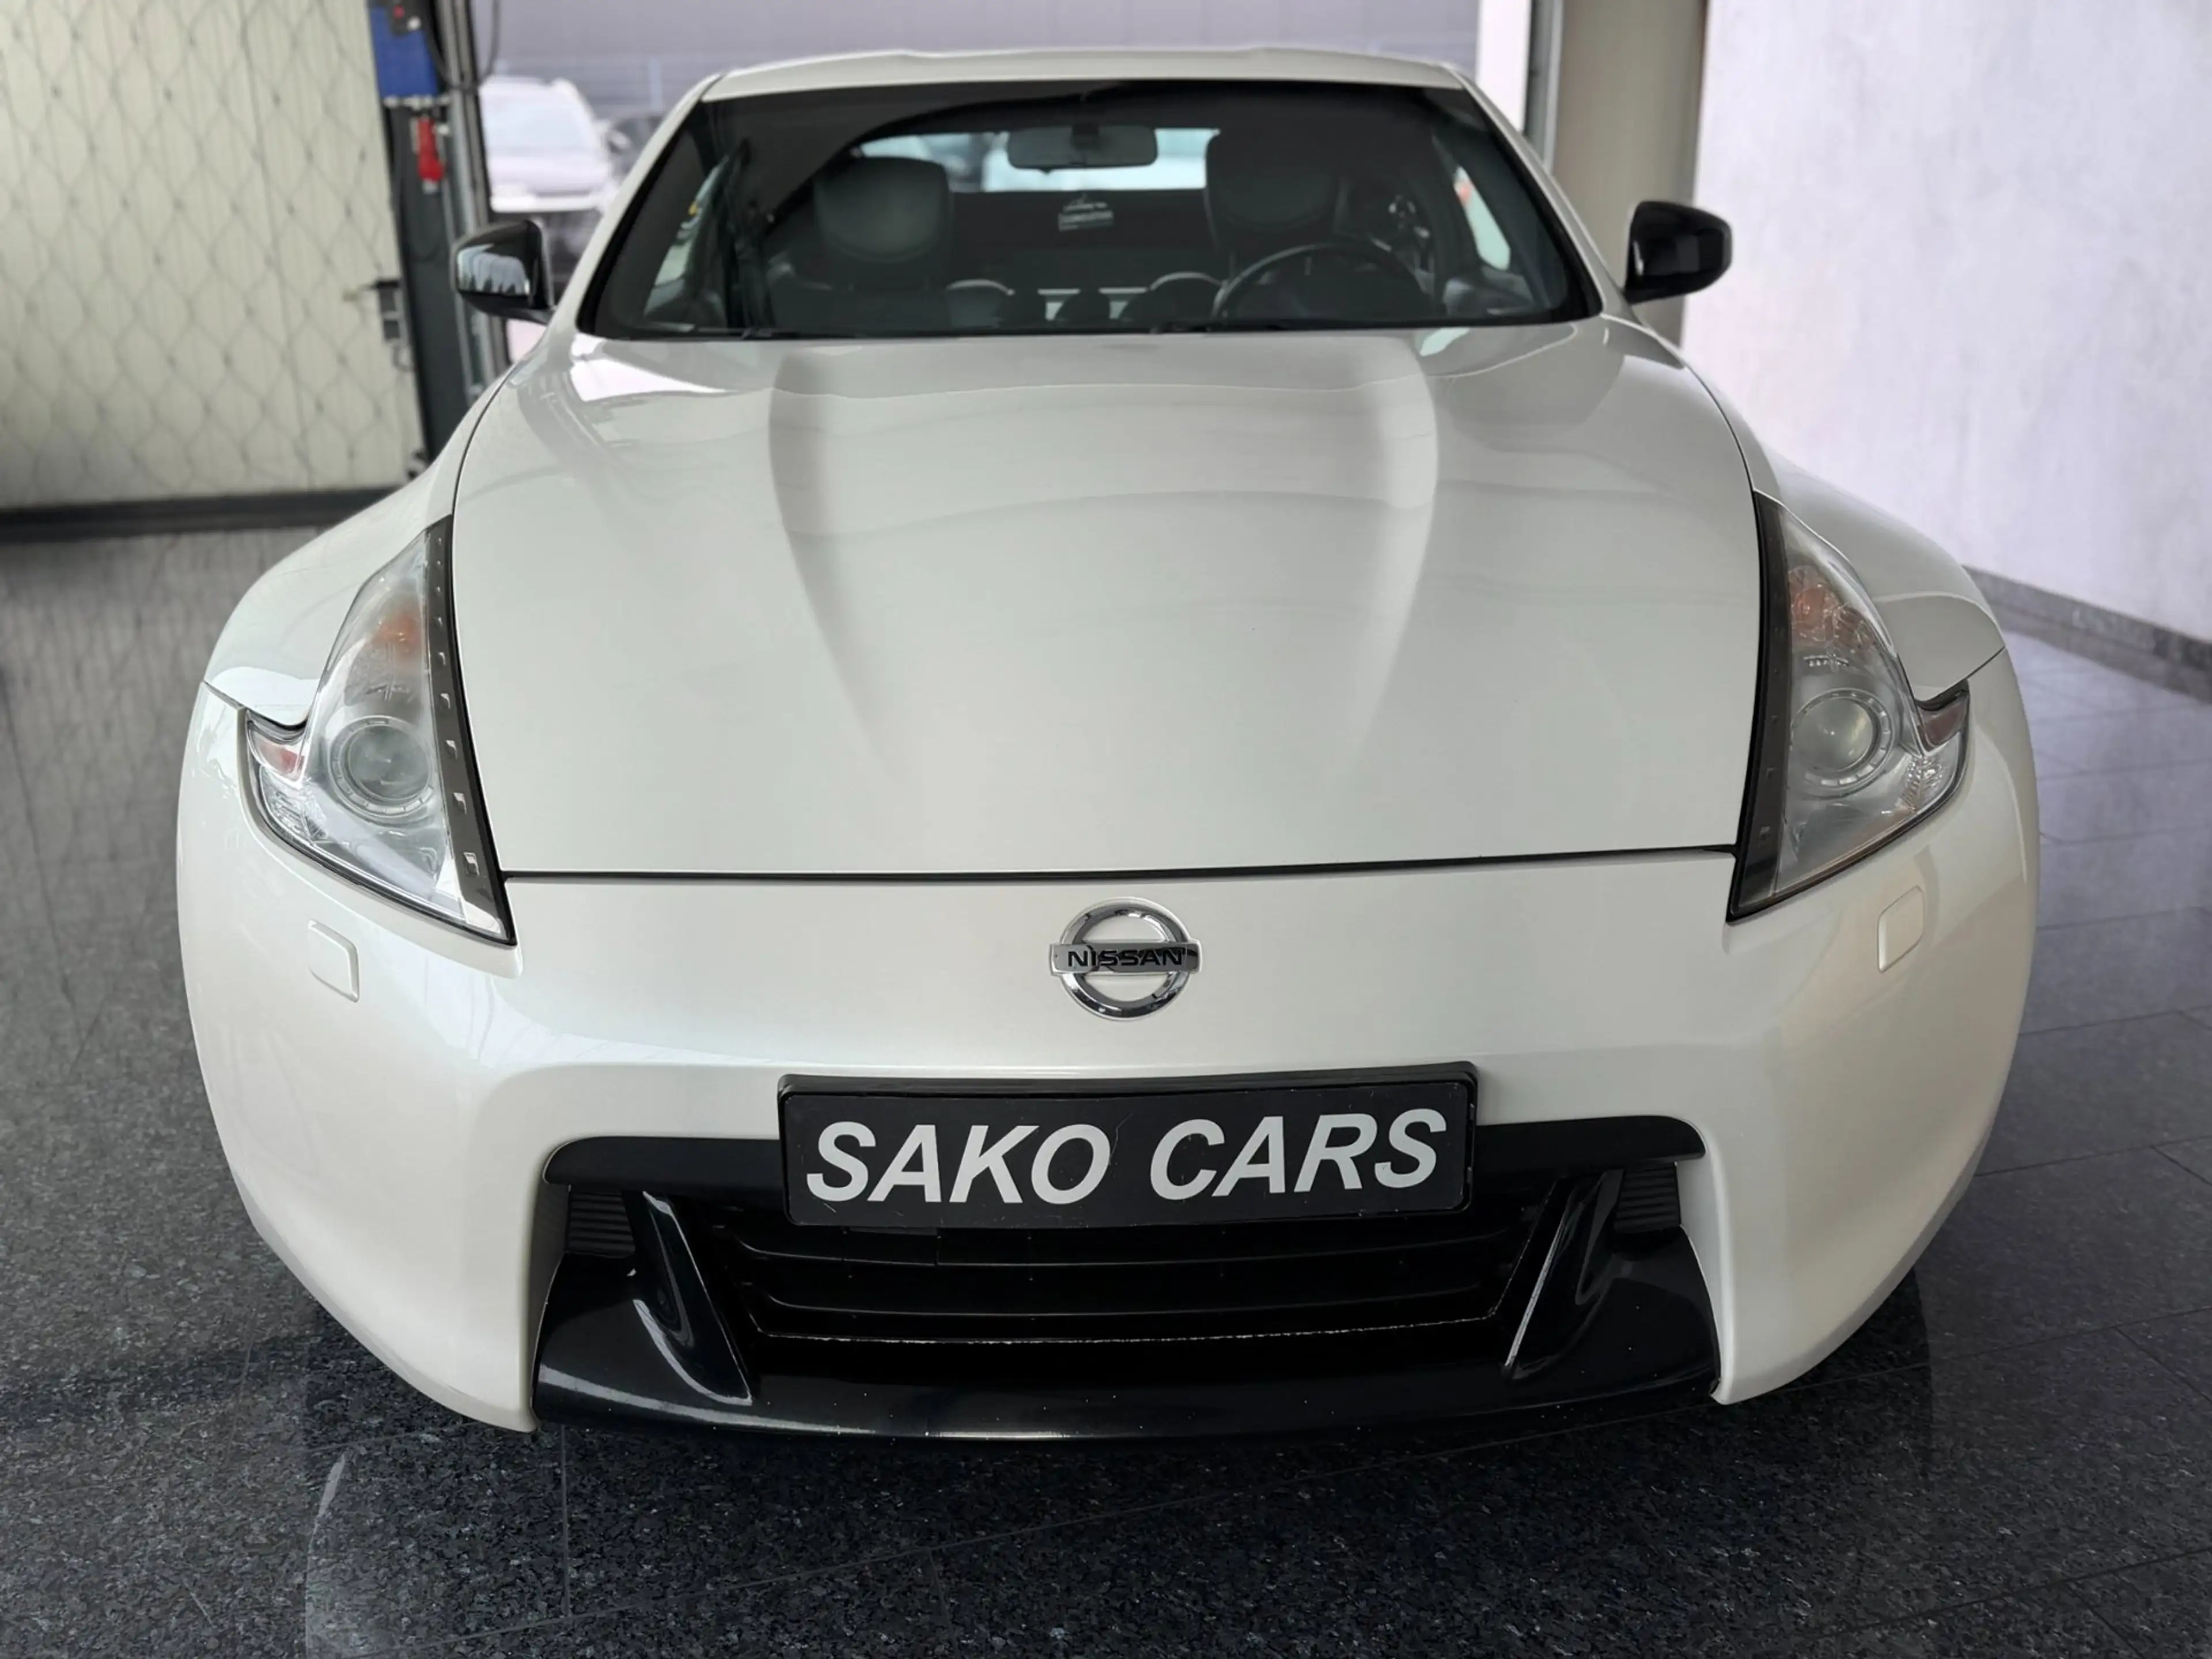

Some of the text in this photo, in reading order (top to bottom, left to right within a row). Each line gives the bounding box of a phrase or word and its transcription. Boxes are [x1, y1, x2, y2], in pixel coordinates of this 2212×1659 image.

[1067, 949, 1183, 967] NISSAN
[806, 1108, 1446, 1205] SAKO CARS
